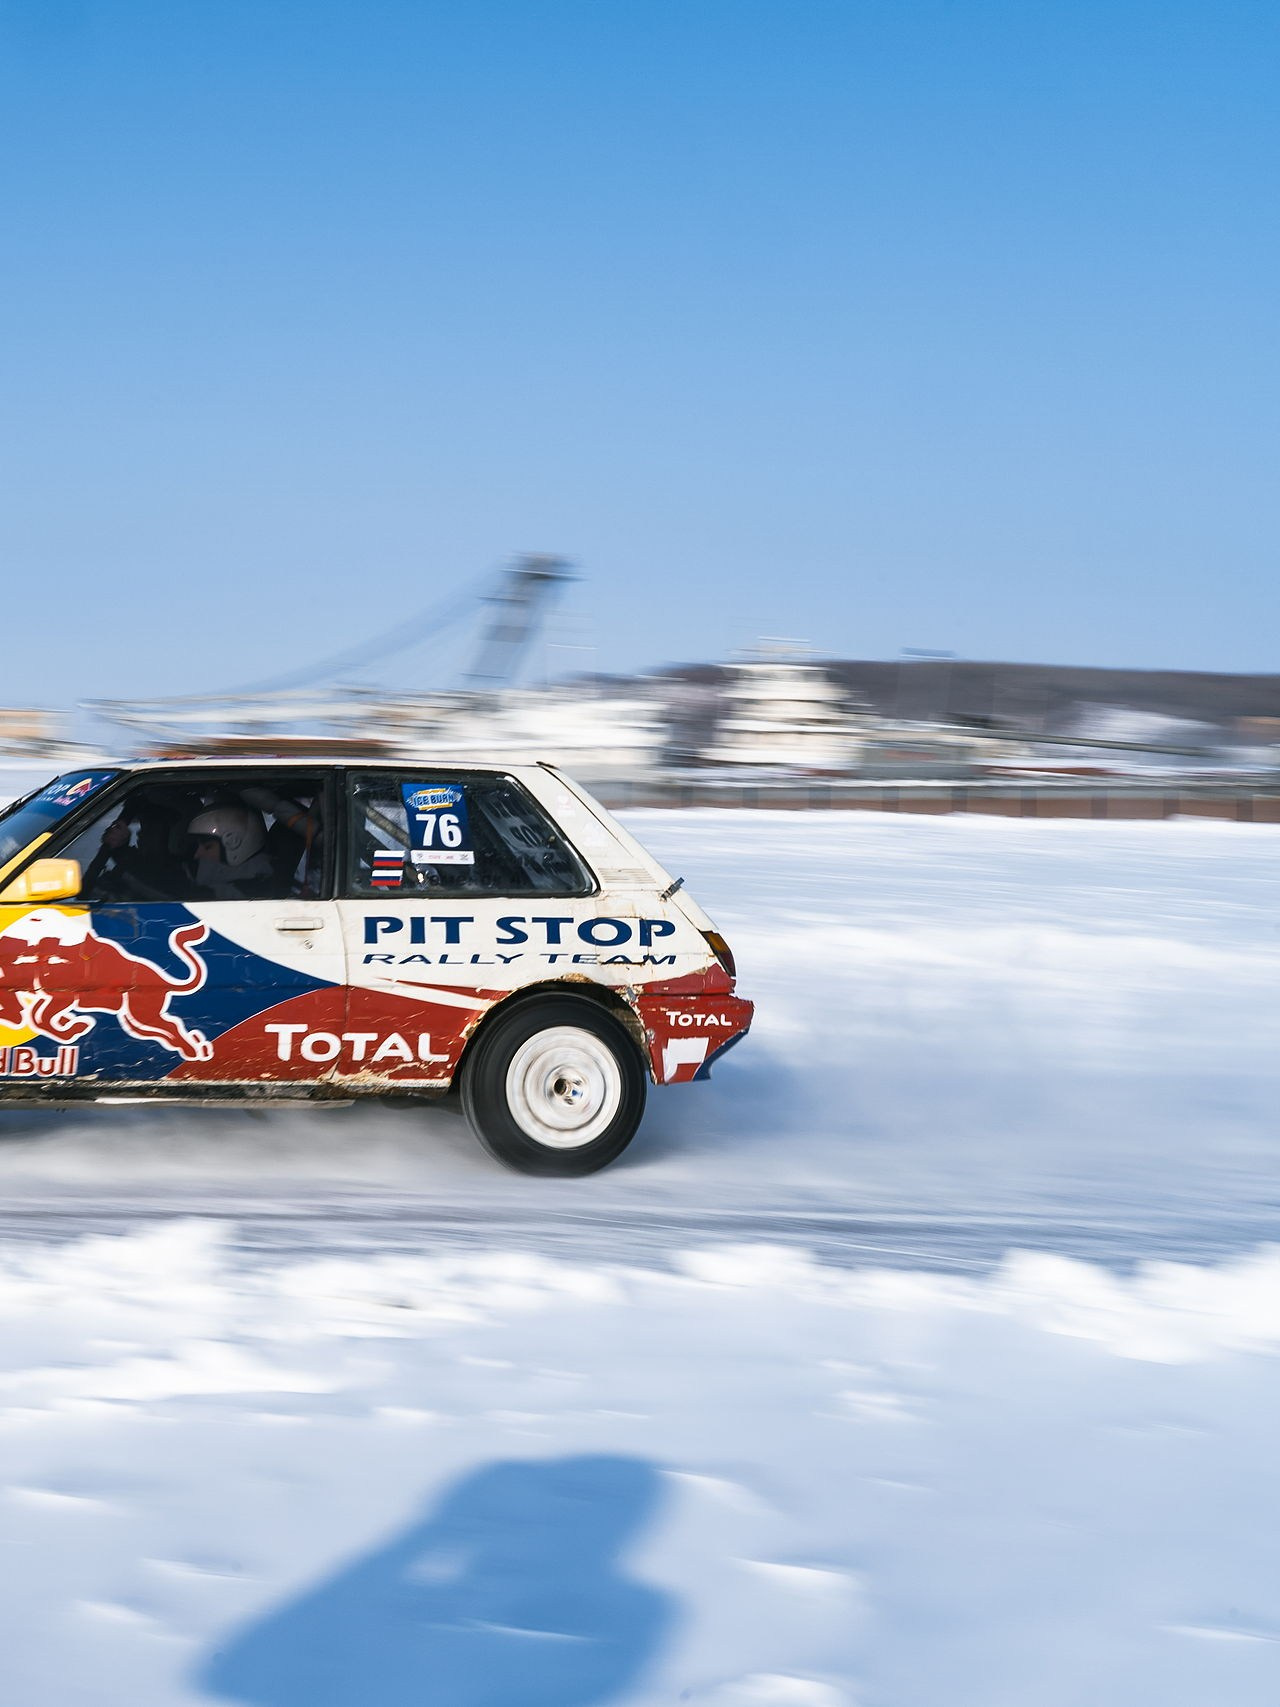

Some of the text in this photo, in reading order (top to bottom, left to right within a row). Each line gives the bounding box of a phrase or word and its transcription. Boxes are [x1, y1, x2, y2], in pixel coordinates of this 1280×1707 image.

[430, 793, 455, 805] BURN
[415, 813, 462, 848] 76
[363, 916, 676, 947] PIT STOP
[362, 953, 677, 965] RALLY TEAM
[665, 1011, 732, 1027] TOTAL
[264, 1024, 450, 1063] TOTAL
[11, 1045, 79, 1077] Bull
